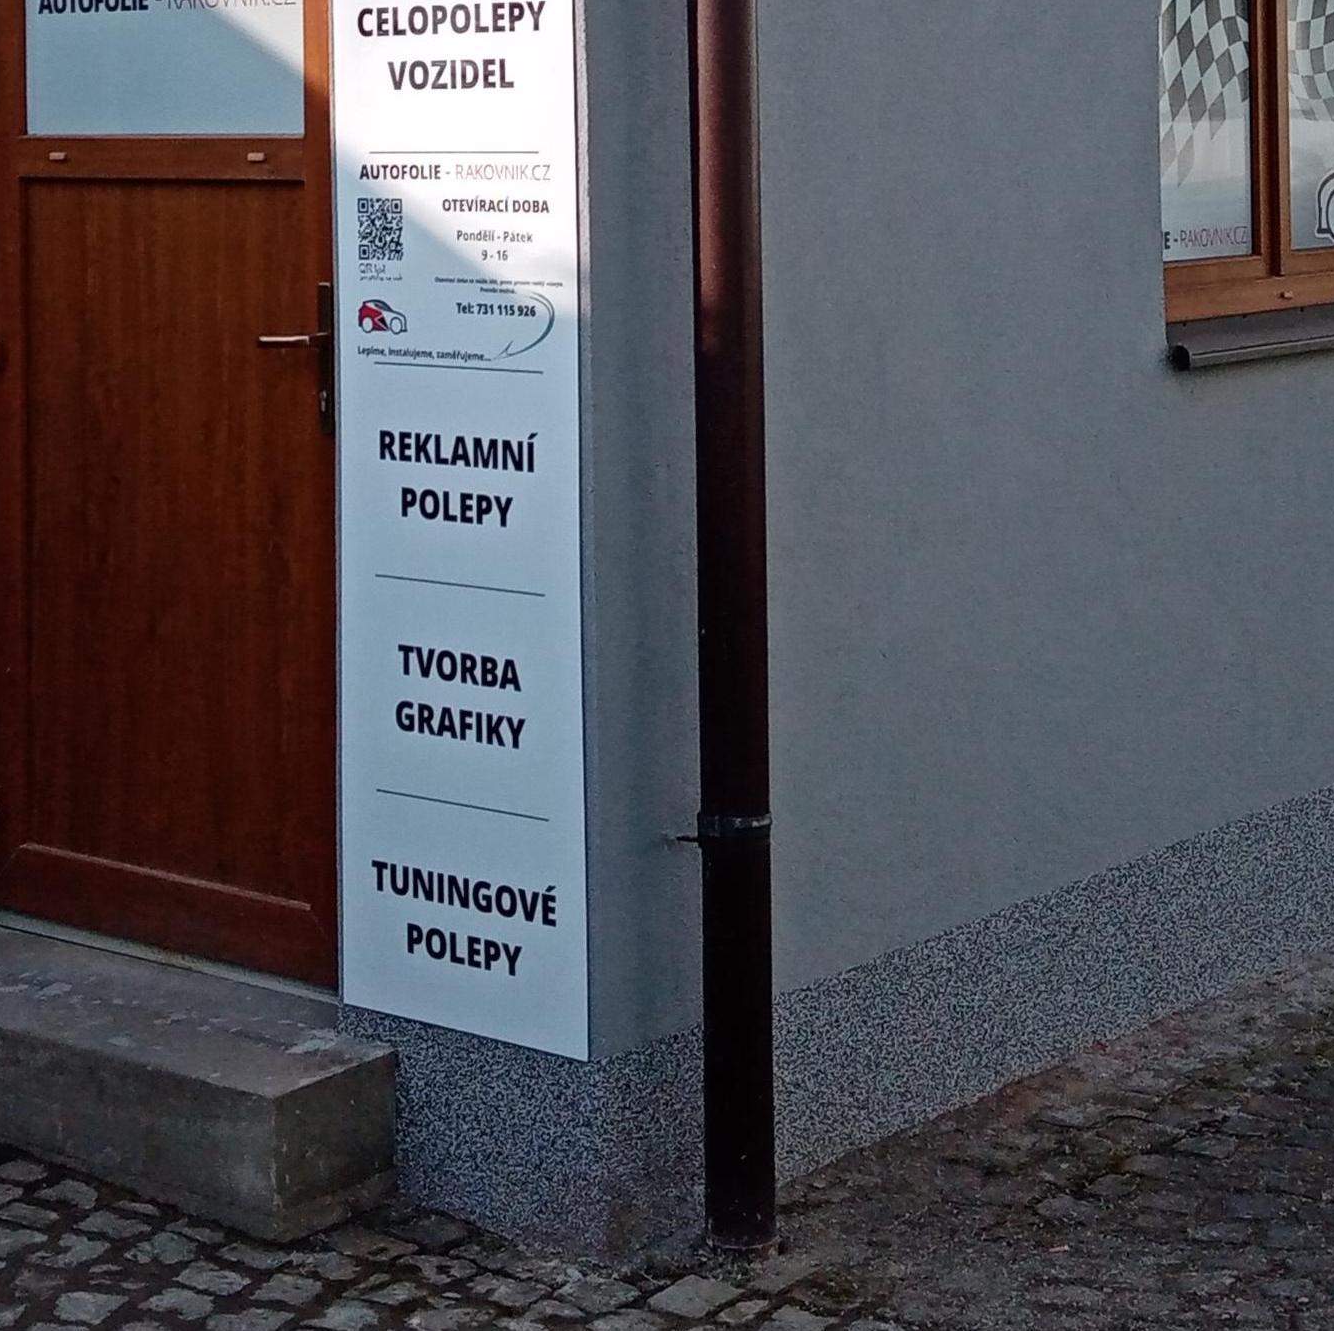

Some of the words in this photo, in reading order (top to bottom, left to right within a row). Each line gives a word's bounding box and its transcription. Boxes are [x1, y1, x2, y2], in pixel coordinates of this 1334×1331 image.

[357, 0, 546, 37] CELOPOLEPY
[388, 58, 515, 91] VOZIDEL
[359, 164, 441, 180] AUTOFOLIE
[455, 164, 551, 181] RAKOVNIK.CZ
[442, 195, 509, 213] OTEVÍRACÍ
[512, 199, 550, 213] DOBA
[481, 250, 487, 261] 9
[497, 250, 508, 261] 16
[476, 303, 495, 315] 731
[498, 304, 515, 316] 115
[518, 305, 536, 317] 926
[379, 429, 538, 473] REKLAMNÍ
[401, 487, 513, 528] POLEPY
[398, 644, 522, 692] TVORBA
[396, 700, 526, 749] GRAFIKY
[371, 859, 557, 927] TUNINGOVÉ
[407, 923, 522, 977] POLEPY
